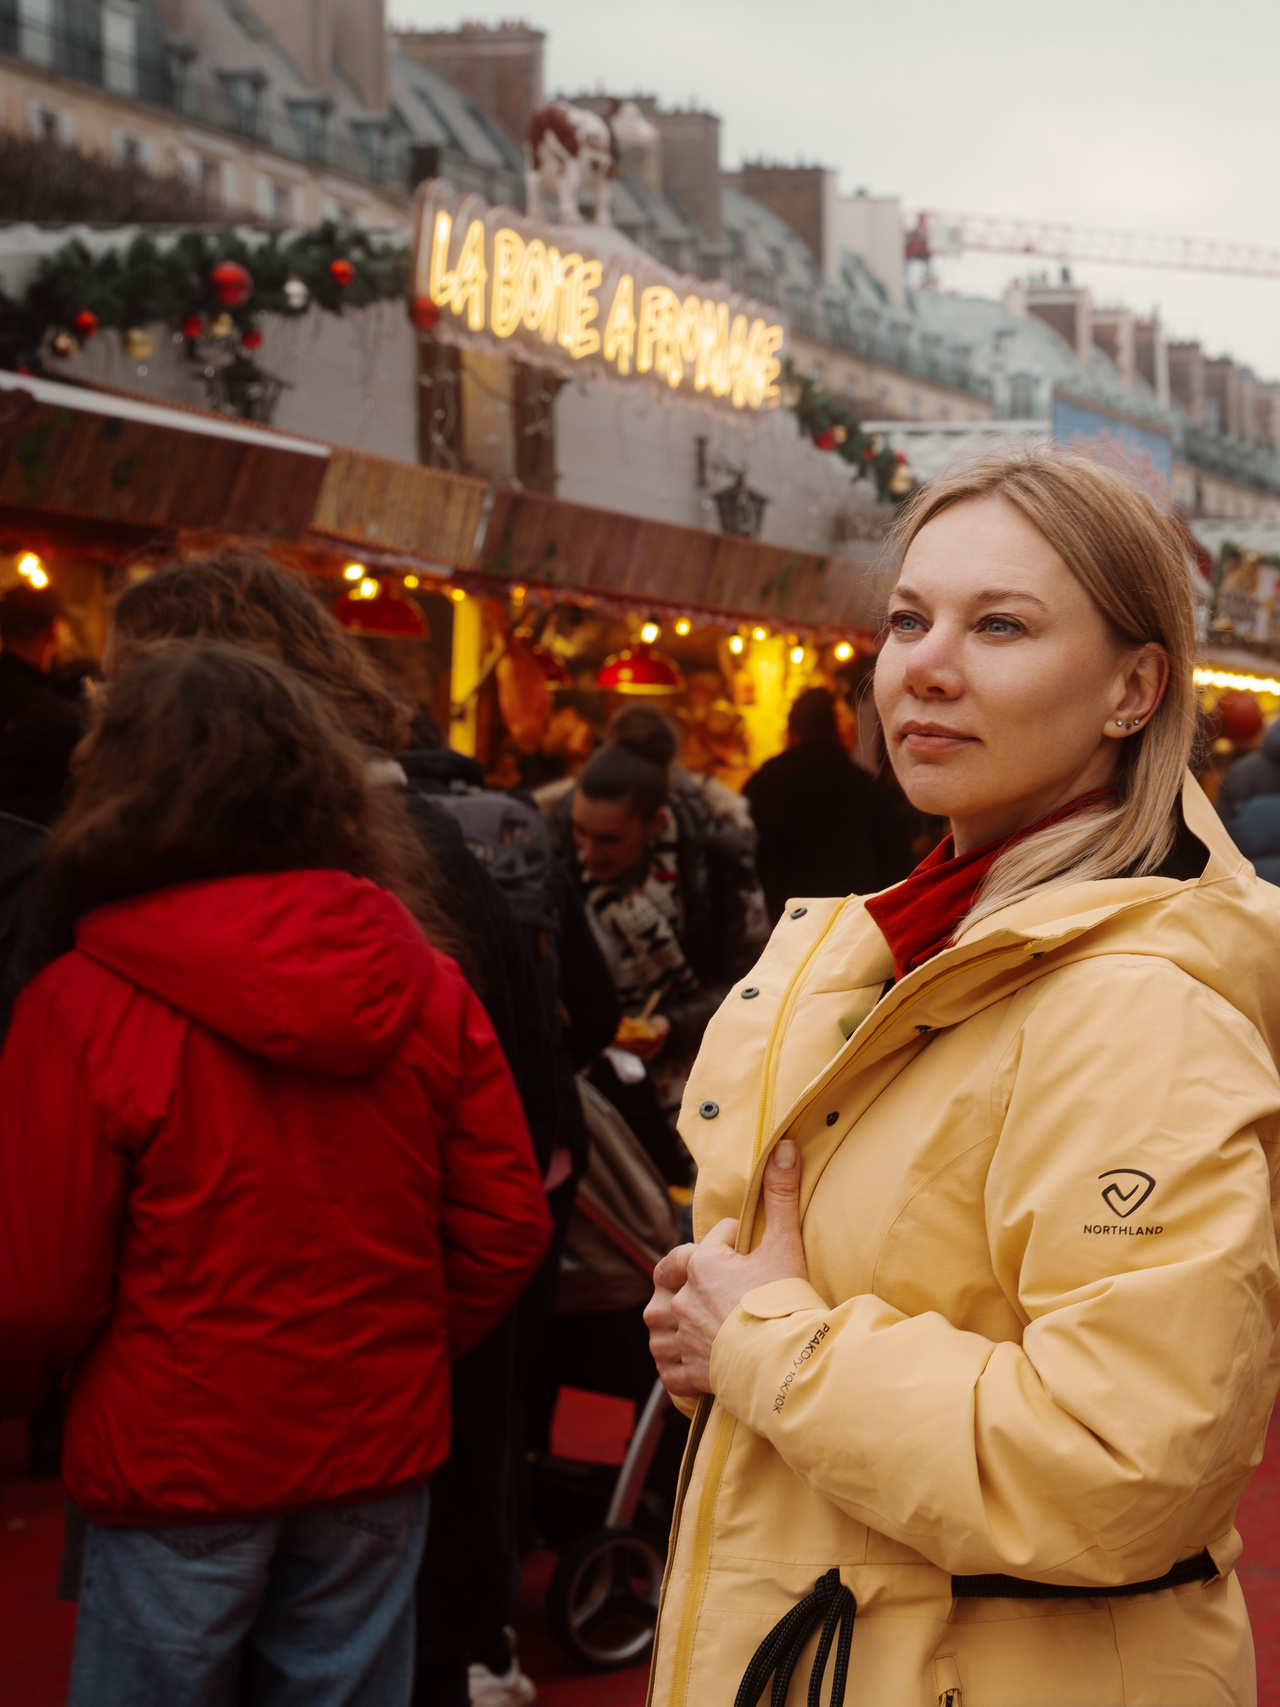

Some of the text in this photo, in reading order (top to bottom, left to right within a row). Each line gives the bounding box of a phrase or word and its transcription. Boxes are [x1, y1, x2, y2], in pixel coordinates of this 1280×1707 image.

[430, 210, 488, 331] LA
[603, 274, 636, 376] A
[1083, 1224, 1164, 1236] NORTHLAND
[772, 1322, 831, 1414] PEAKDry 10K/10K
